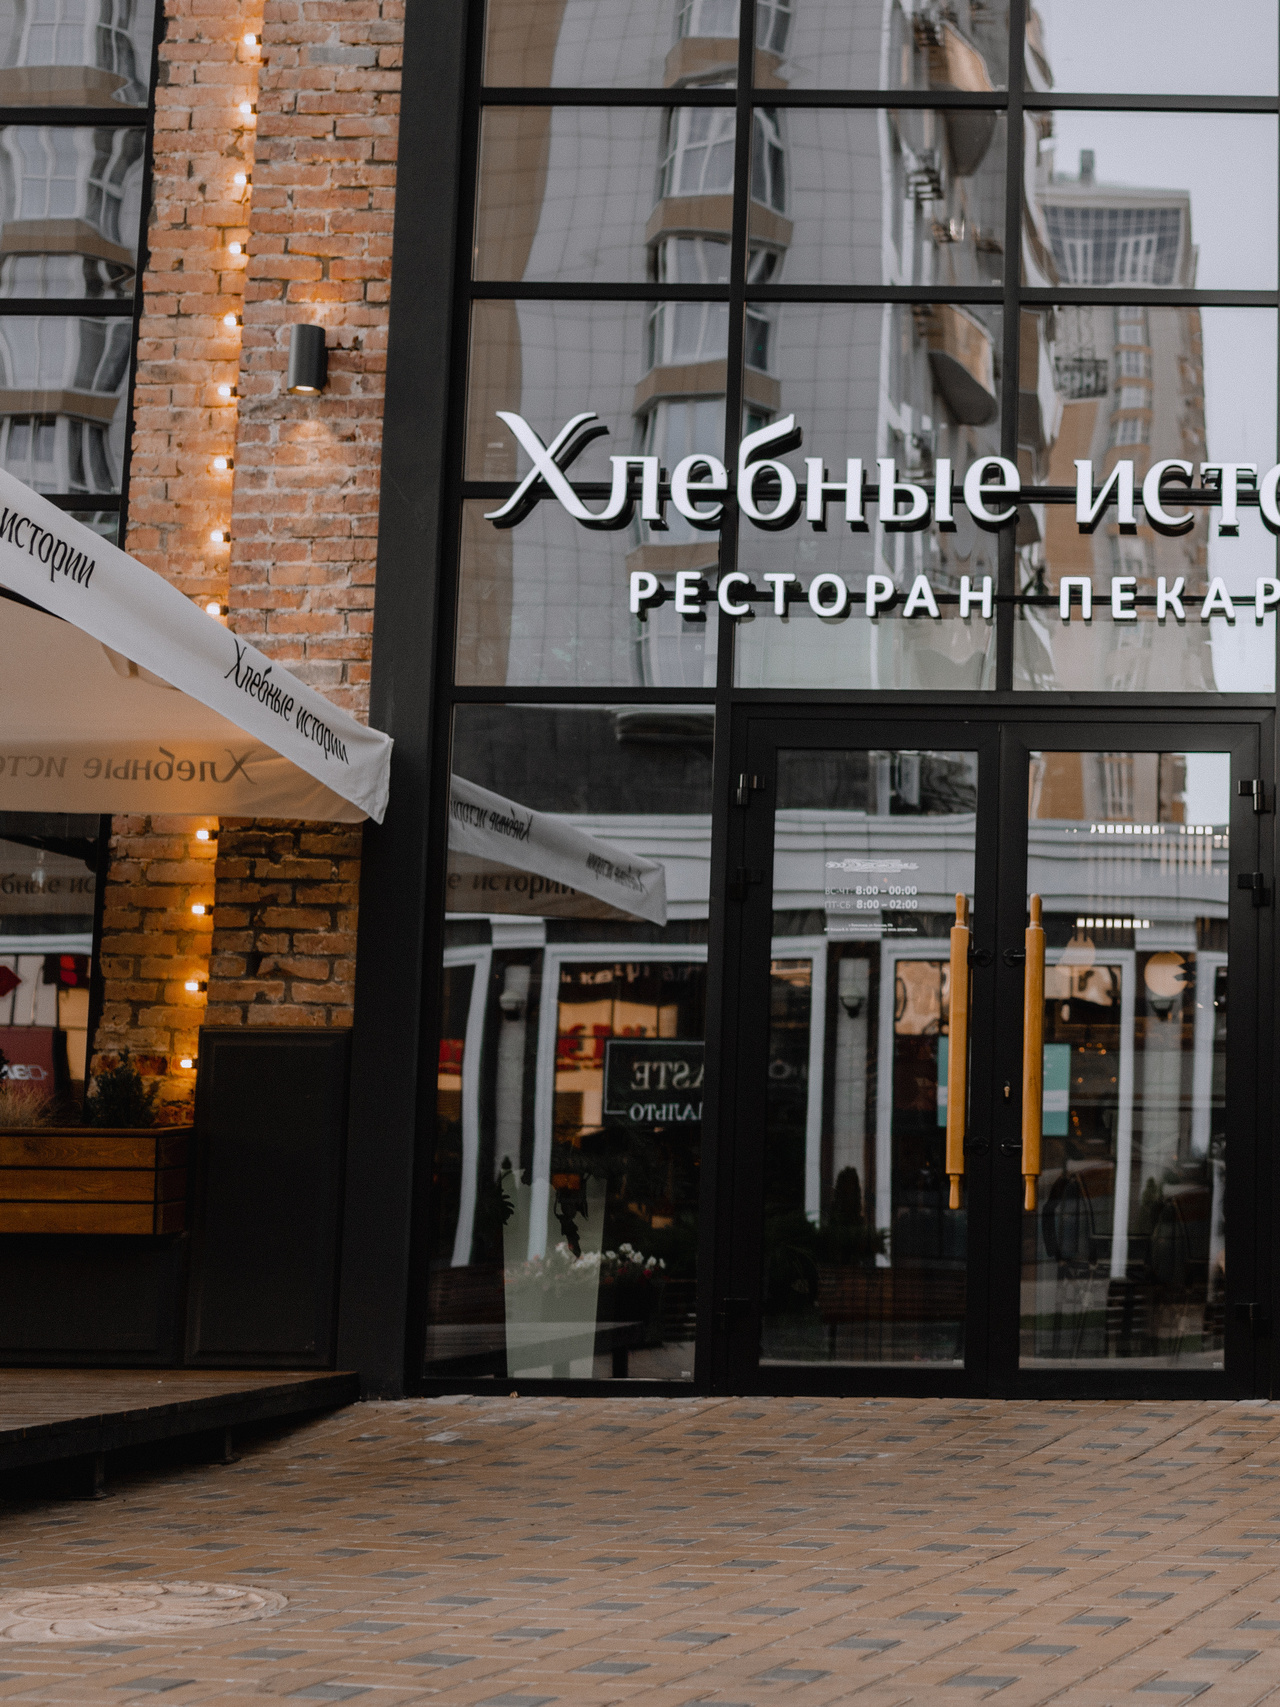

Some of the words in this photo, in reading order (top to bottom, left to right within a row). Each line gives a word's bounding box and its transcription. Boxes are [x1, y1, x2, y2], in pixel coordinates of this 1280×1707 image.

[484, 411, 1022, 522] Хлебные
[0, 507, 96, 589] истории
[629, 571, 994, 619] РЕСТОРАН
[224, 638, 294, 721] Хлебные
[296, 706, 350, 765] истории
[855, 885, 879, 895] 8:00
[888, 885, 918, 895] 00:00
[856, 899, 880, 909] 8:00
[889, 899, 918, 909] 02:00
